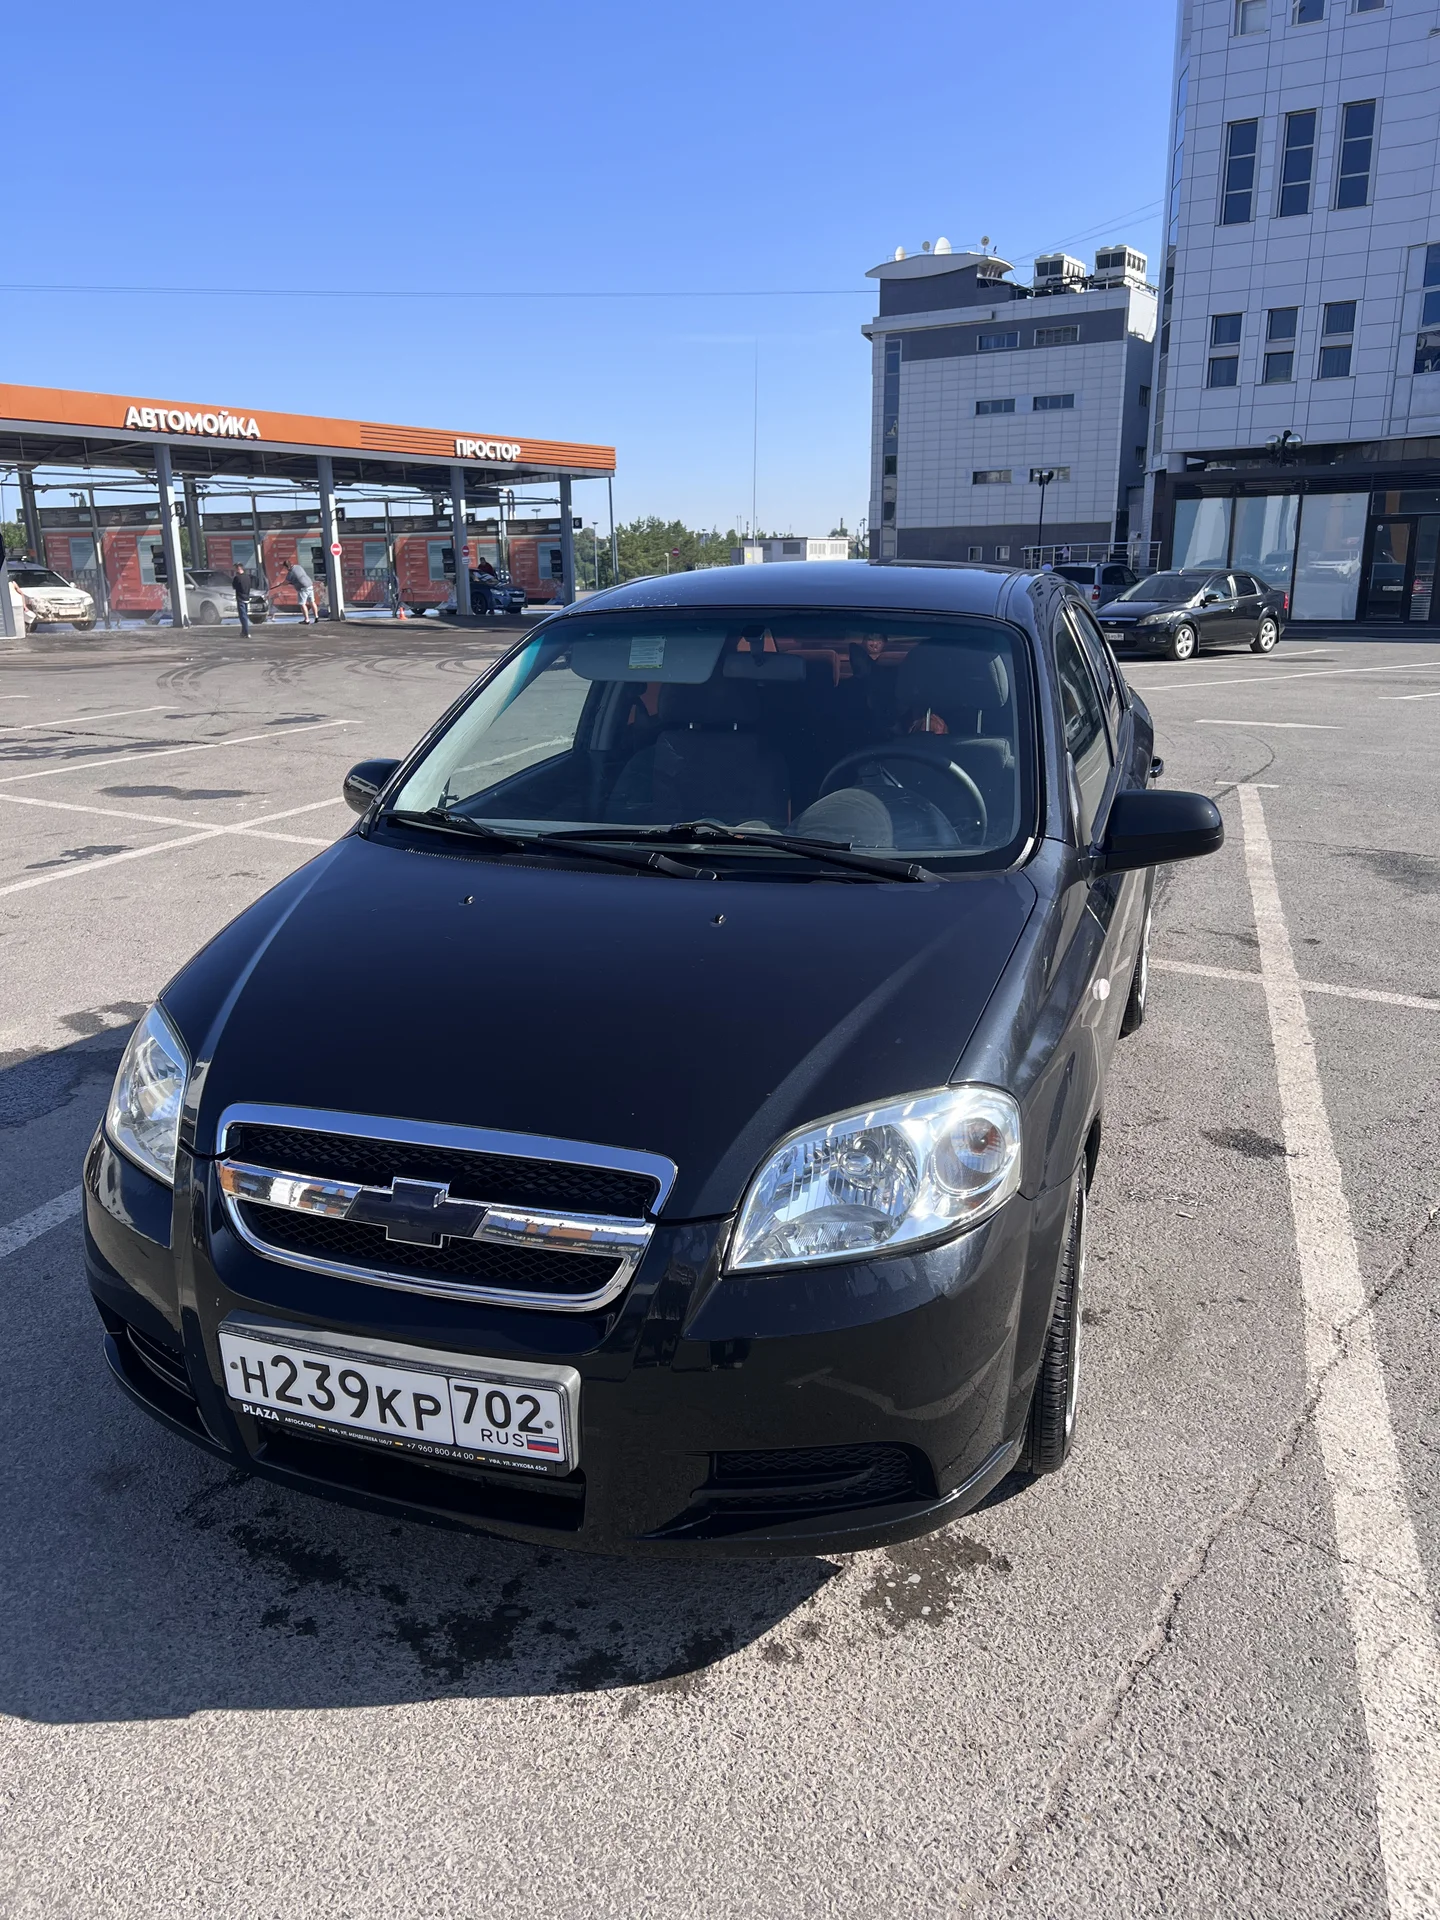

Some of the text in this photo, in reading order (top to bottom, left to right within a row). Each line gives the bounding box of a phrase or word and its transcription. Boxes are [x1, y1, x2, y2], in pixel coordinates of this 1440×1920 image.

[125, 405, 261, 437] АВТОМОЙКА
[456, 439, 521, 461] ПРОСТОР
[176, 504, 182, 514] 3
[468, 515, 473, 524] 5
[453, 1384, 544, 1435] 702
[242, 1403, 280, 1421] PLAZA
[284, 1417, 316, 1429] АВТОСАЛОН
[406, 1442, 416, 1450] +7
[417, 1444, 433, 1453] 960
[434, 1447, 450, 1456] 800
[451, 1450, 462, 1458] 44
[463, 1452, 474, 1460] 00
[512, 1461, 534, 1470] ЖУКОВА
[480, 1428, 525, 1448] RUS
